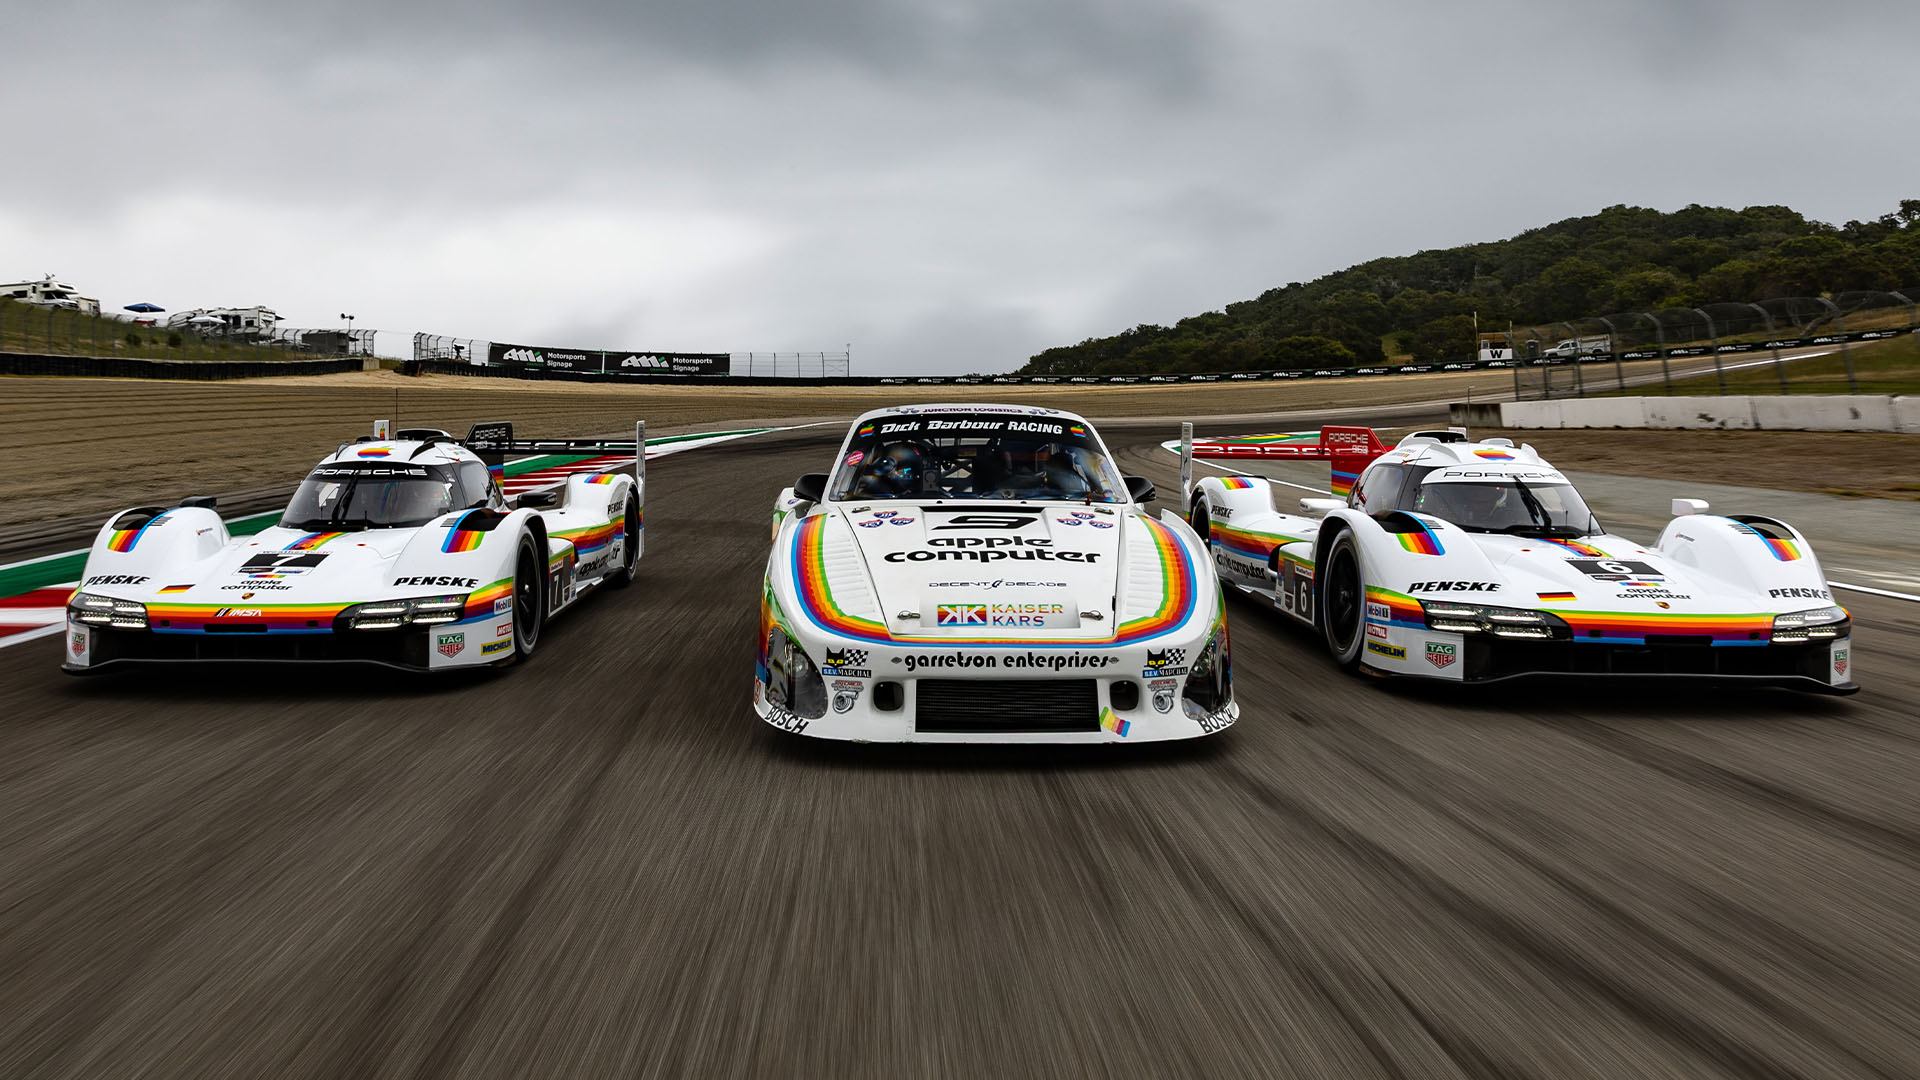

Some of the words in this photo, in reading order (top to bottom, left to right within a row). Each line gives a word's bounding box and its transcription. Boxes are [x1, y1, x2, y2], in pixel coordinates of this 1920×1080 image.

[547, 352, 586, 360] Motorsports
[1490, 350, 1503, 358] W
[547, 360, 573, 368] Signage
[673, 364, 700, 372] Signage
[475, 427, 506, 440] PORSCHE
[881, 421, 921, 434] Dick
[926, 420, 1005, 431] Barbour
[1008, 421, 1063, 435] RACING
[1328, 432, 1369, 444] PORSCHE
[1444, 471, 1565, 480] PORSCHE
[608, 500, 624, 515] PENSKE
[1210, 504, 1234, 518] PENSKE
[931, 515, 1039, 531] 9
[927, 536, 1053, 548] apple
[270, 554, 306, 567] 7
[884, 549, 1101, 563] computer
[1597, 561, 1633, 574] 6
[84, 575, 151, 587] PENSKE
[393, 576, 480, 588] PENSKE
[554, 575, 560, 605] 7
[1407, 581, 1502, 594] PENSKE
[1300, 581, 1307, 612] 6
[1768, 588, 1830, 600] PENSKE
[229, 608, 262, 617] IMSA
[992, 604, 1063, 614] KAISER
[992, 615, 1045, 626] KARS
[1367, 625, 1386, 637] MOTUL
[440, 635, 463, 644] TAG
[440, 643, 463, 655] HEUER
[482, 639, 512, 654] MICHELIN
[1428, 645, 1453, 654] TAG
[904, 652, 997, 671] garretson
[1003, 652, 1109, 671] enterprises
[1426, 653, 1455, 665] HEUER
[838, 669, 871, 677] MARCHAL
[764, 707, 810, 734] BOSCH
